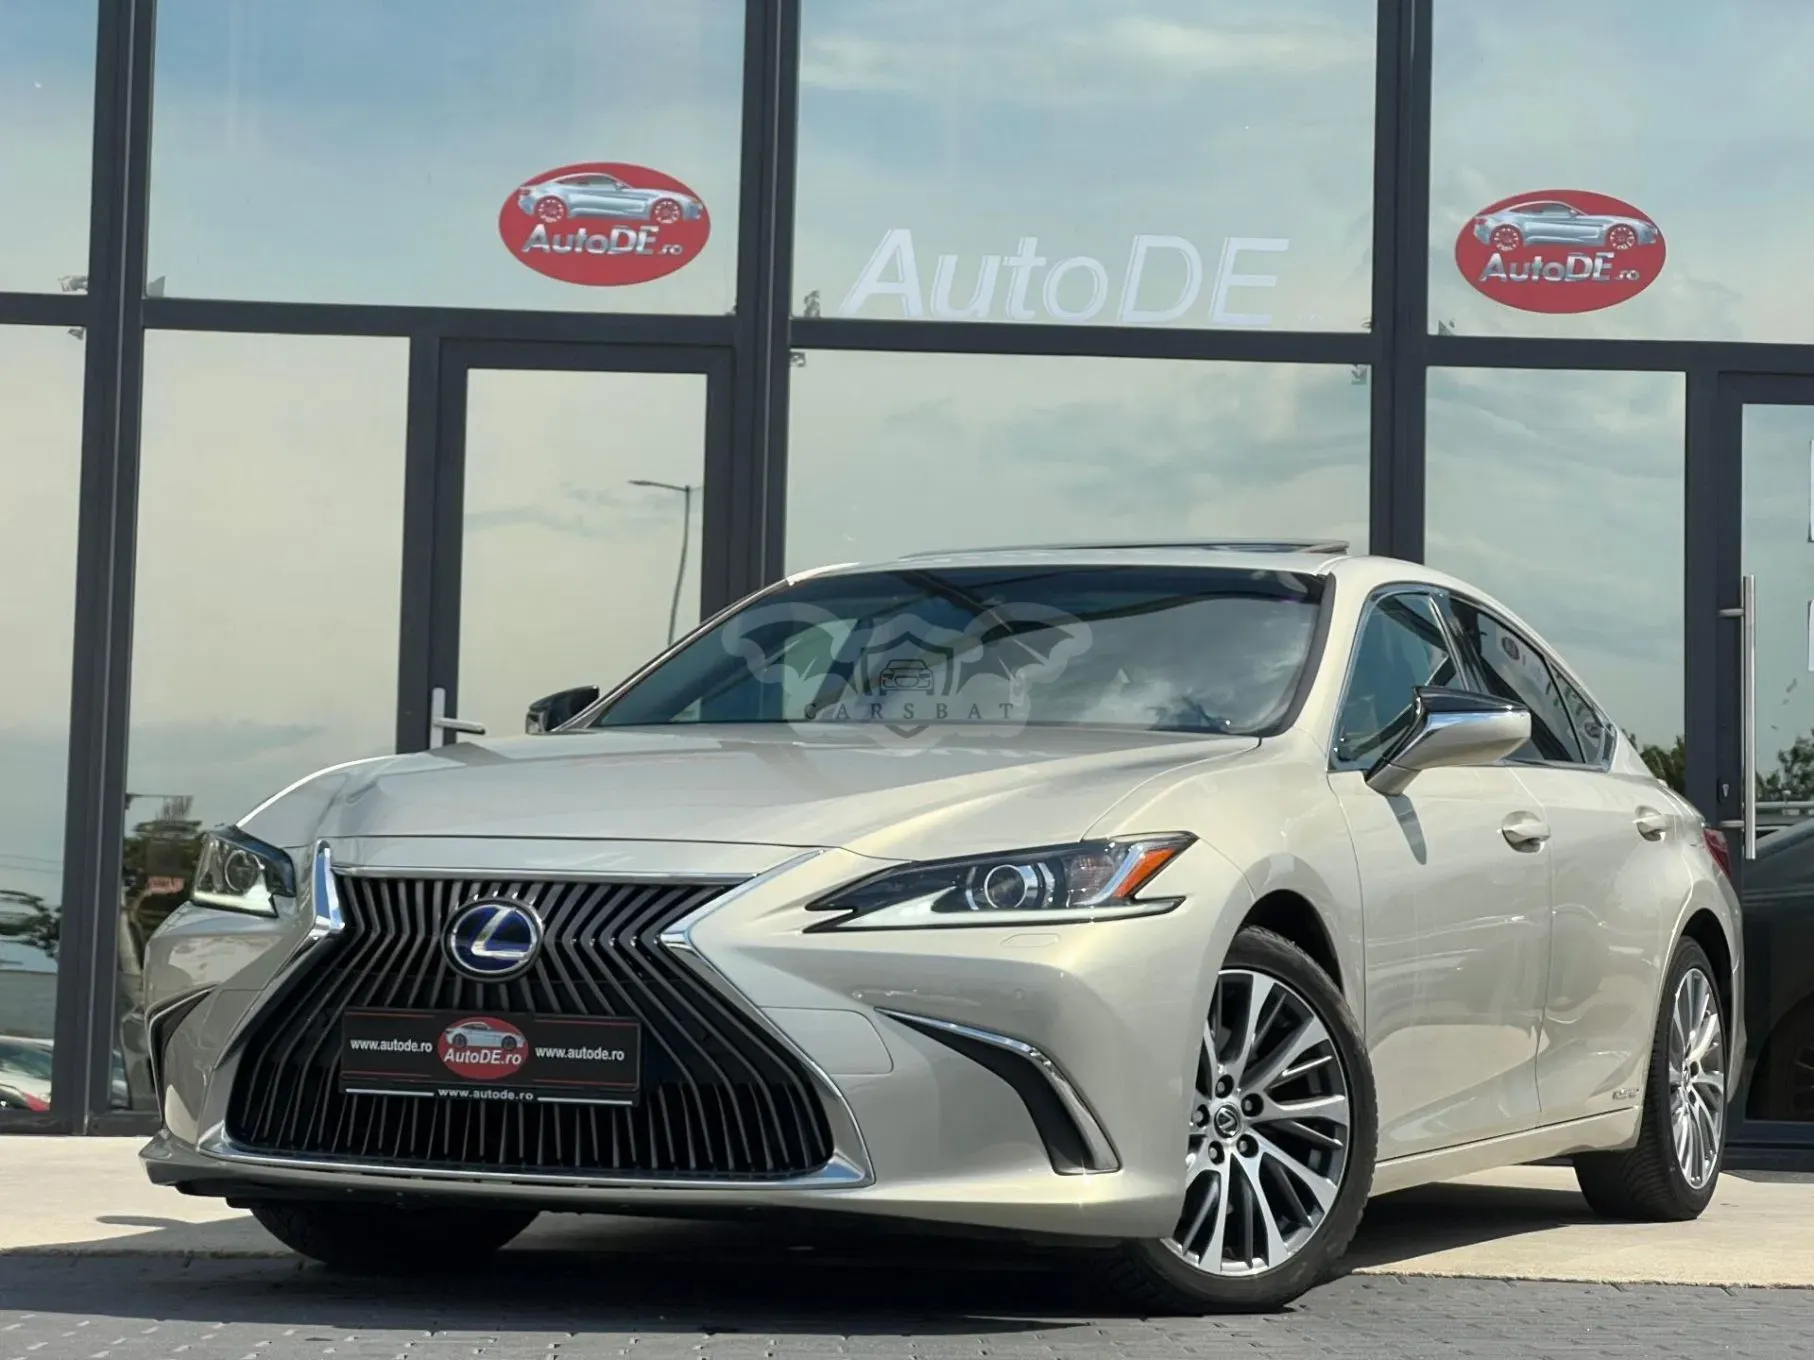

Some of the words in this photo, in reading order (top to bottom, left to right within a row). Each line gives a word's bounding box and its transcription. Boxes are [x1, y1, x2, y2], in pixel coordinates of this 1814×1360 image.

[838, 228, 1290, 325] AutoDE
[350, 1038, 433, 1053] www.autode.ro
[443, 1048, 522, 1066] AutoDE.ro
[535, 1046, 624, 1061] www.autode.ro
[438, 1088, 534, 1101] www.autode.ro
